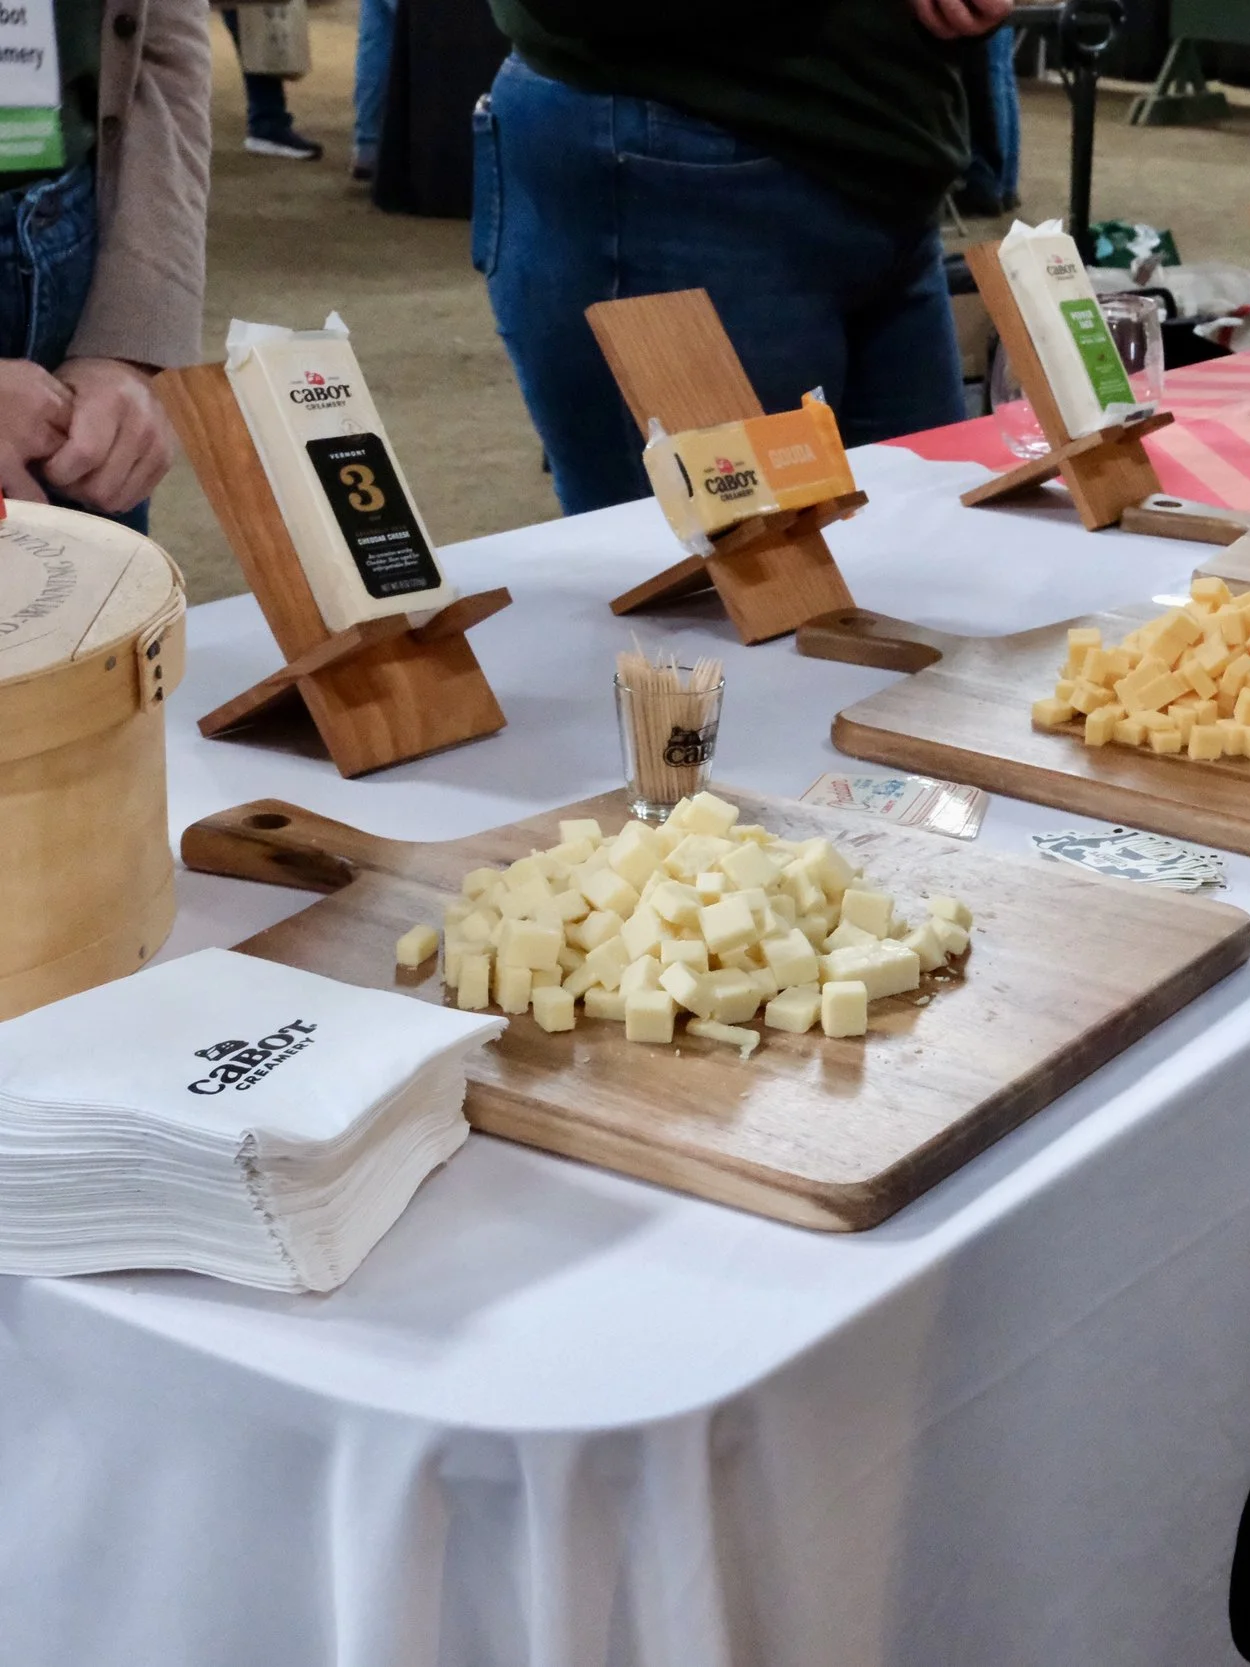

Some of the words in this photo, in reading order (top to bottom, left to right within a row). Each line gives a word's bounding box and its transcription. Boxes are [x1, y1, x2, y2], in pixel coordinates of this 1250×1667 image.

[289, 384, 352, 404] CaBOT
[305, 400, 347, 411] CREAMERY
[329, 449, 366, 460] VERMONT
[768, 444, 817, 469] GOUDA
[339, 463, 386, 513] 3
[704, 470, 759, 495] CaBOT
[357, 534, 387, 546] CHEDDAR
[187, 1019, 317, 1095] CaBOT
[235, 1037, 315, 1091] CREAMERY
